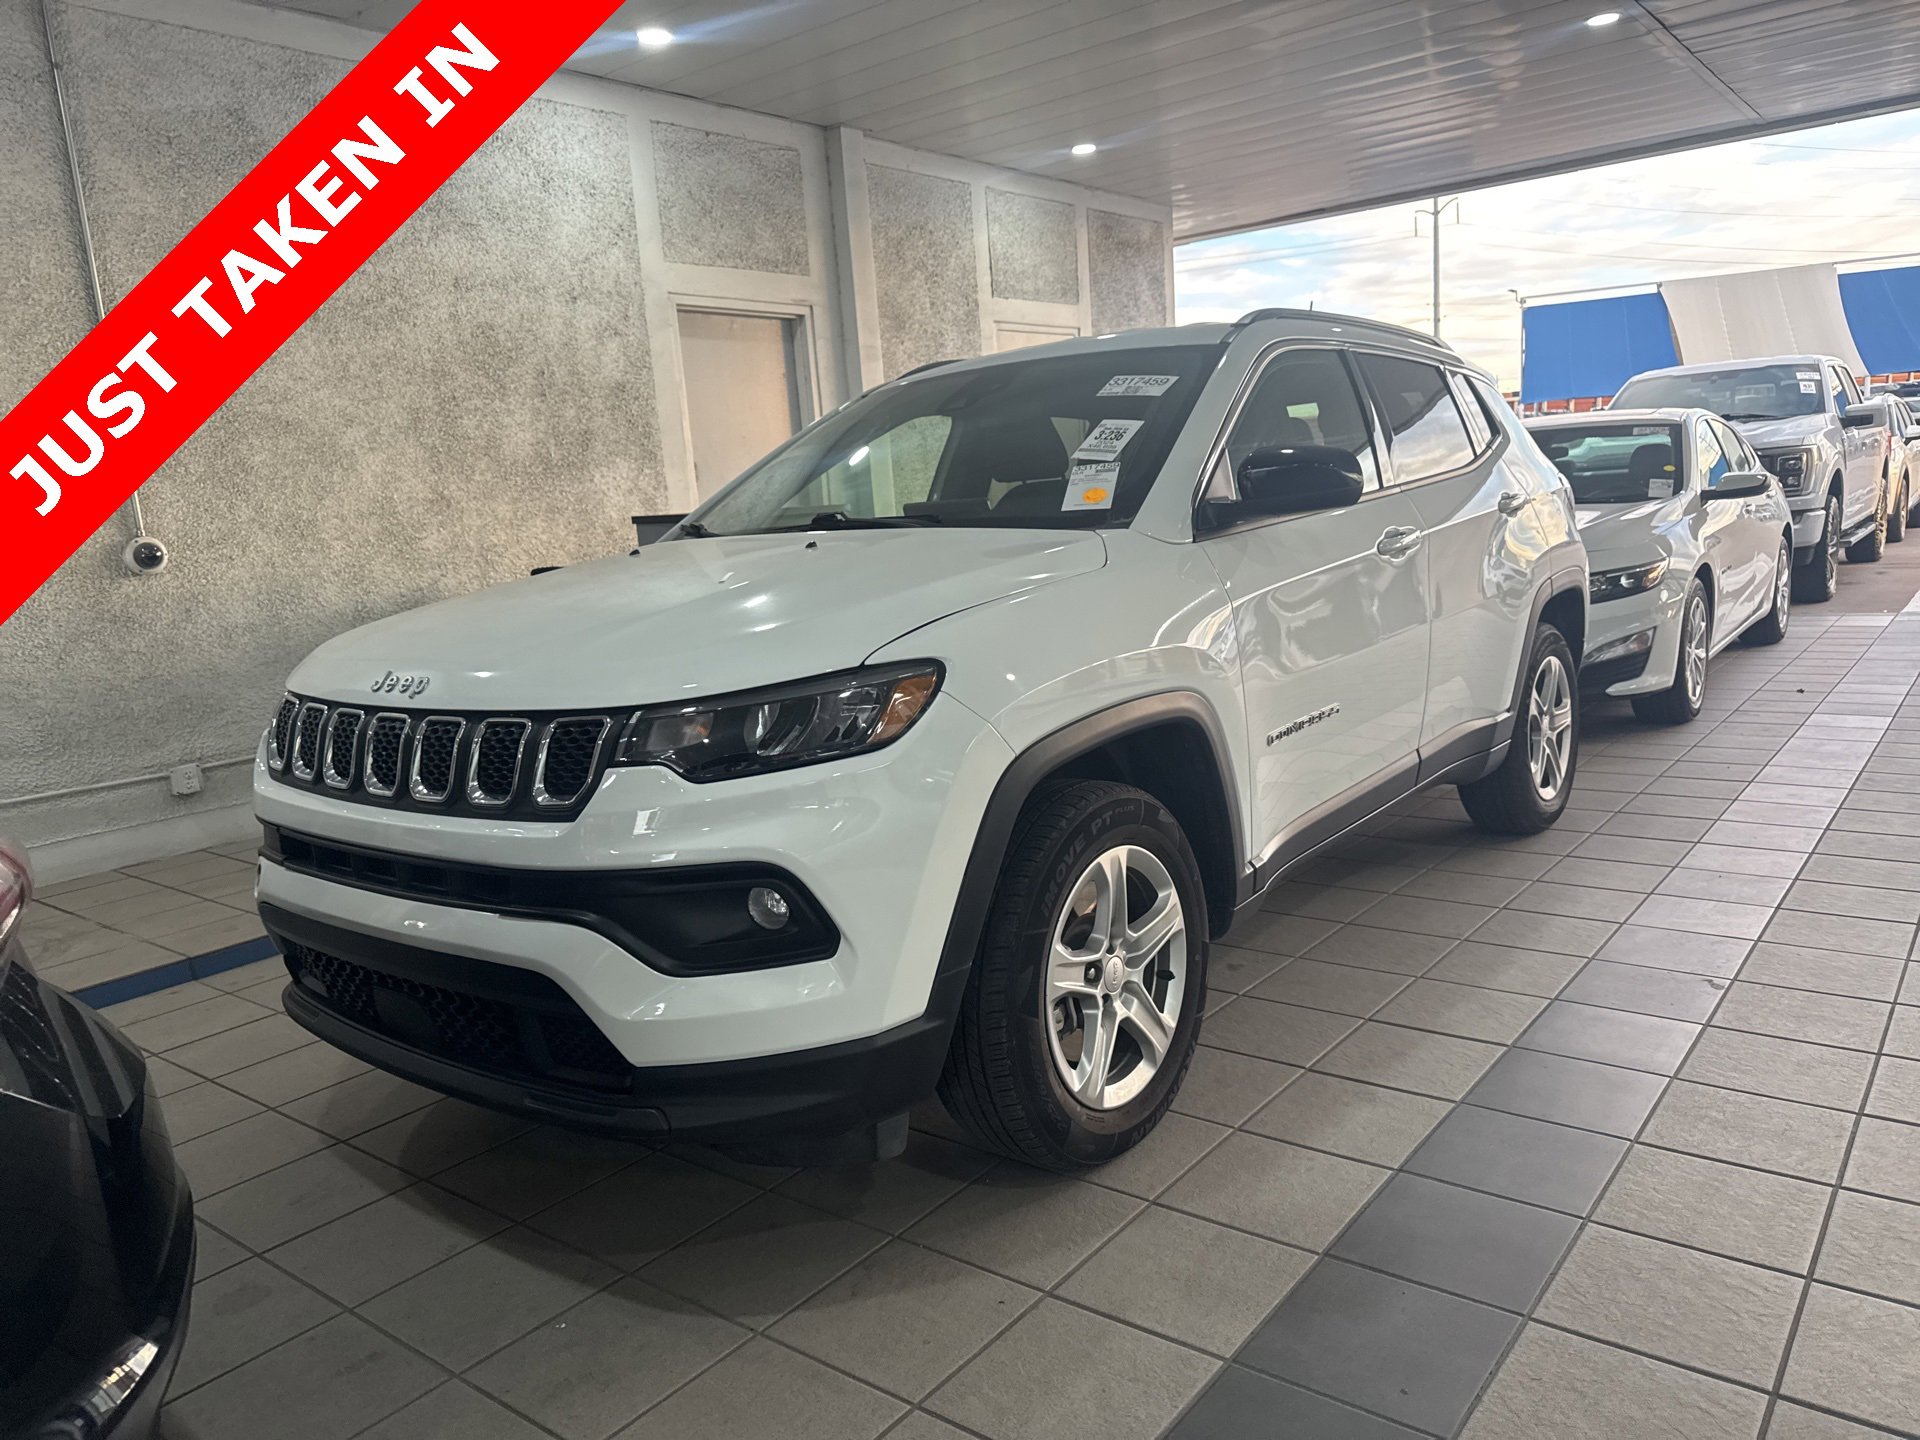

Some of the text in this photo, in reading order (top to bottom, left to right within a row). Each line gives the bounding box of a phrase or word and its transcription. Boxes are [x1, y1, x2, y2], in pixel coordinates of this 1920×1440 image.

[1108, 376, 1170, 387] 3317459
[370, 669, 431, 700] Jeep
[1090, 811, 1113, 836] PT
